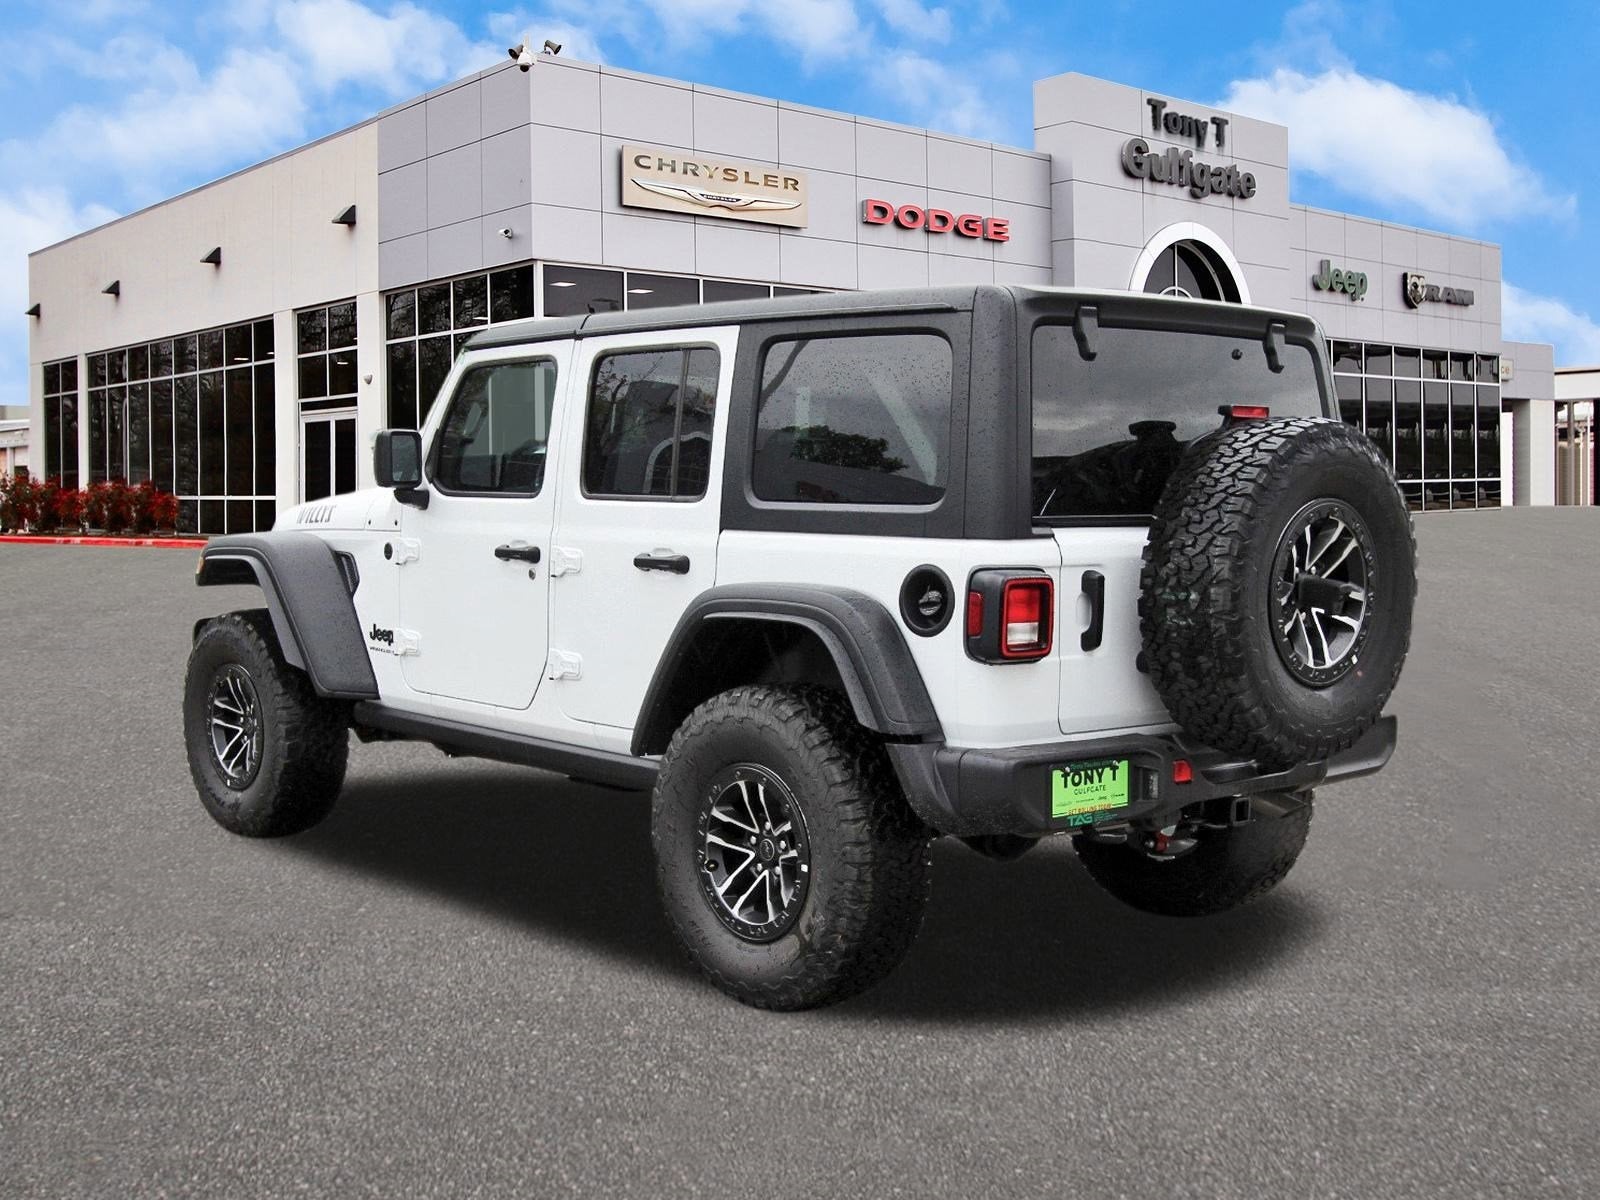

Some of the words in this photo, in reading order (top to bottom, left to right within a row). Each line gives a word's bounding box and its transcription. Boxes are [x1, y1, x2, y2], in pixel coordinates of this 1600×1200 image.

[1146, 98, 1208, 148] Tony
[1210, 116, 1229, 147] T
[633, 154, 800, 191] CHRYSLER
[1121, 137, 1256, 199] Gulfgate
[862, 199, 1010, 242] DODGE
[1312, 259, 1368, 302] Jeep
[1424, 284, 1475, 306] RAM
[369, 623, 394, 646] Jeep
[1061, 767, 1106, 789] TONY
[1110, 763, 1120, 781] T
[1067, 813, 1093, 827] TAG
